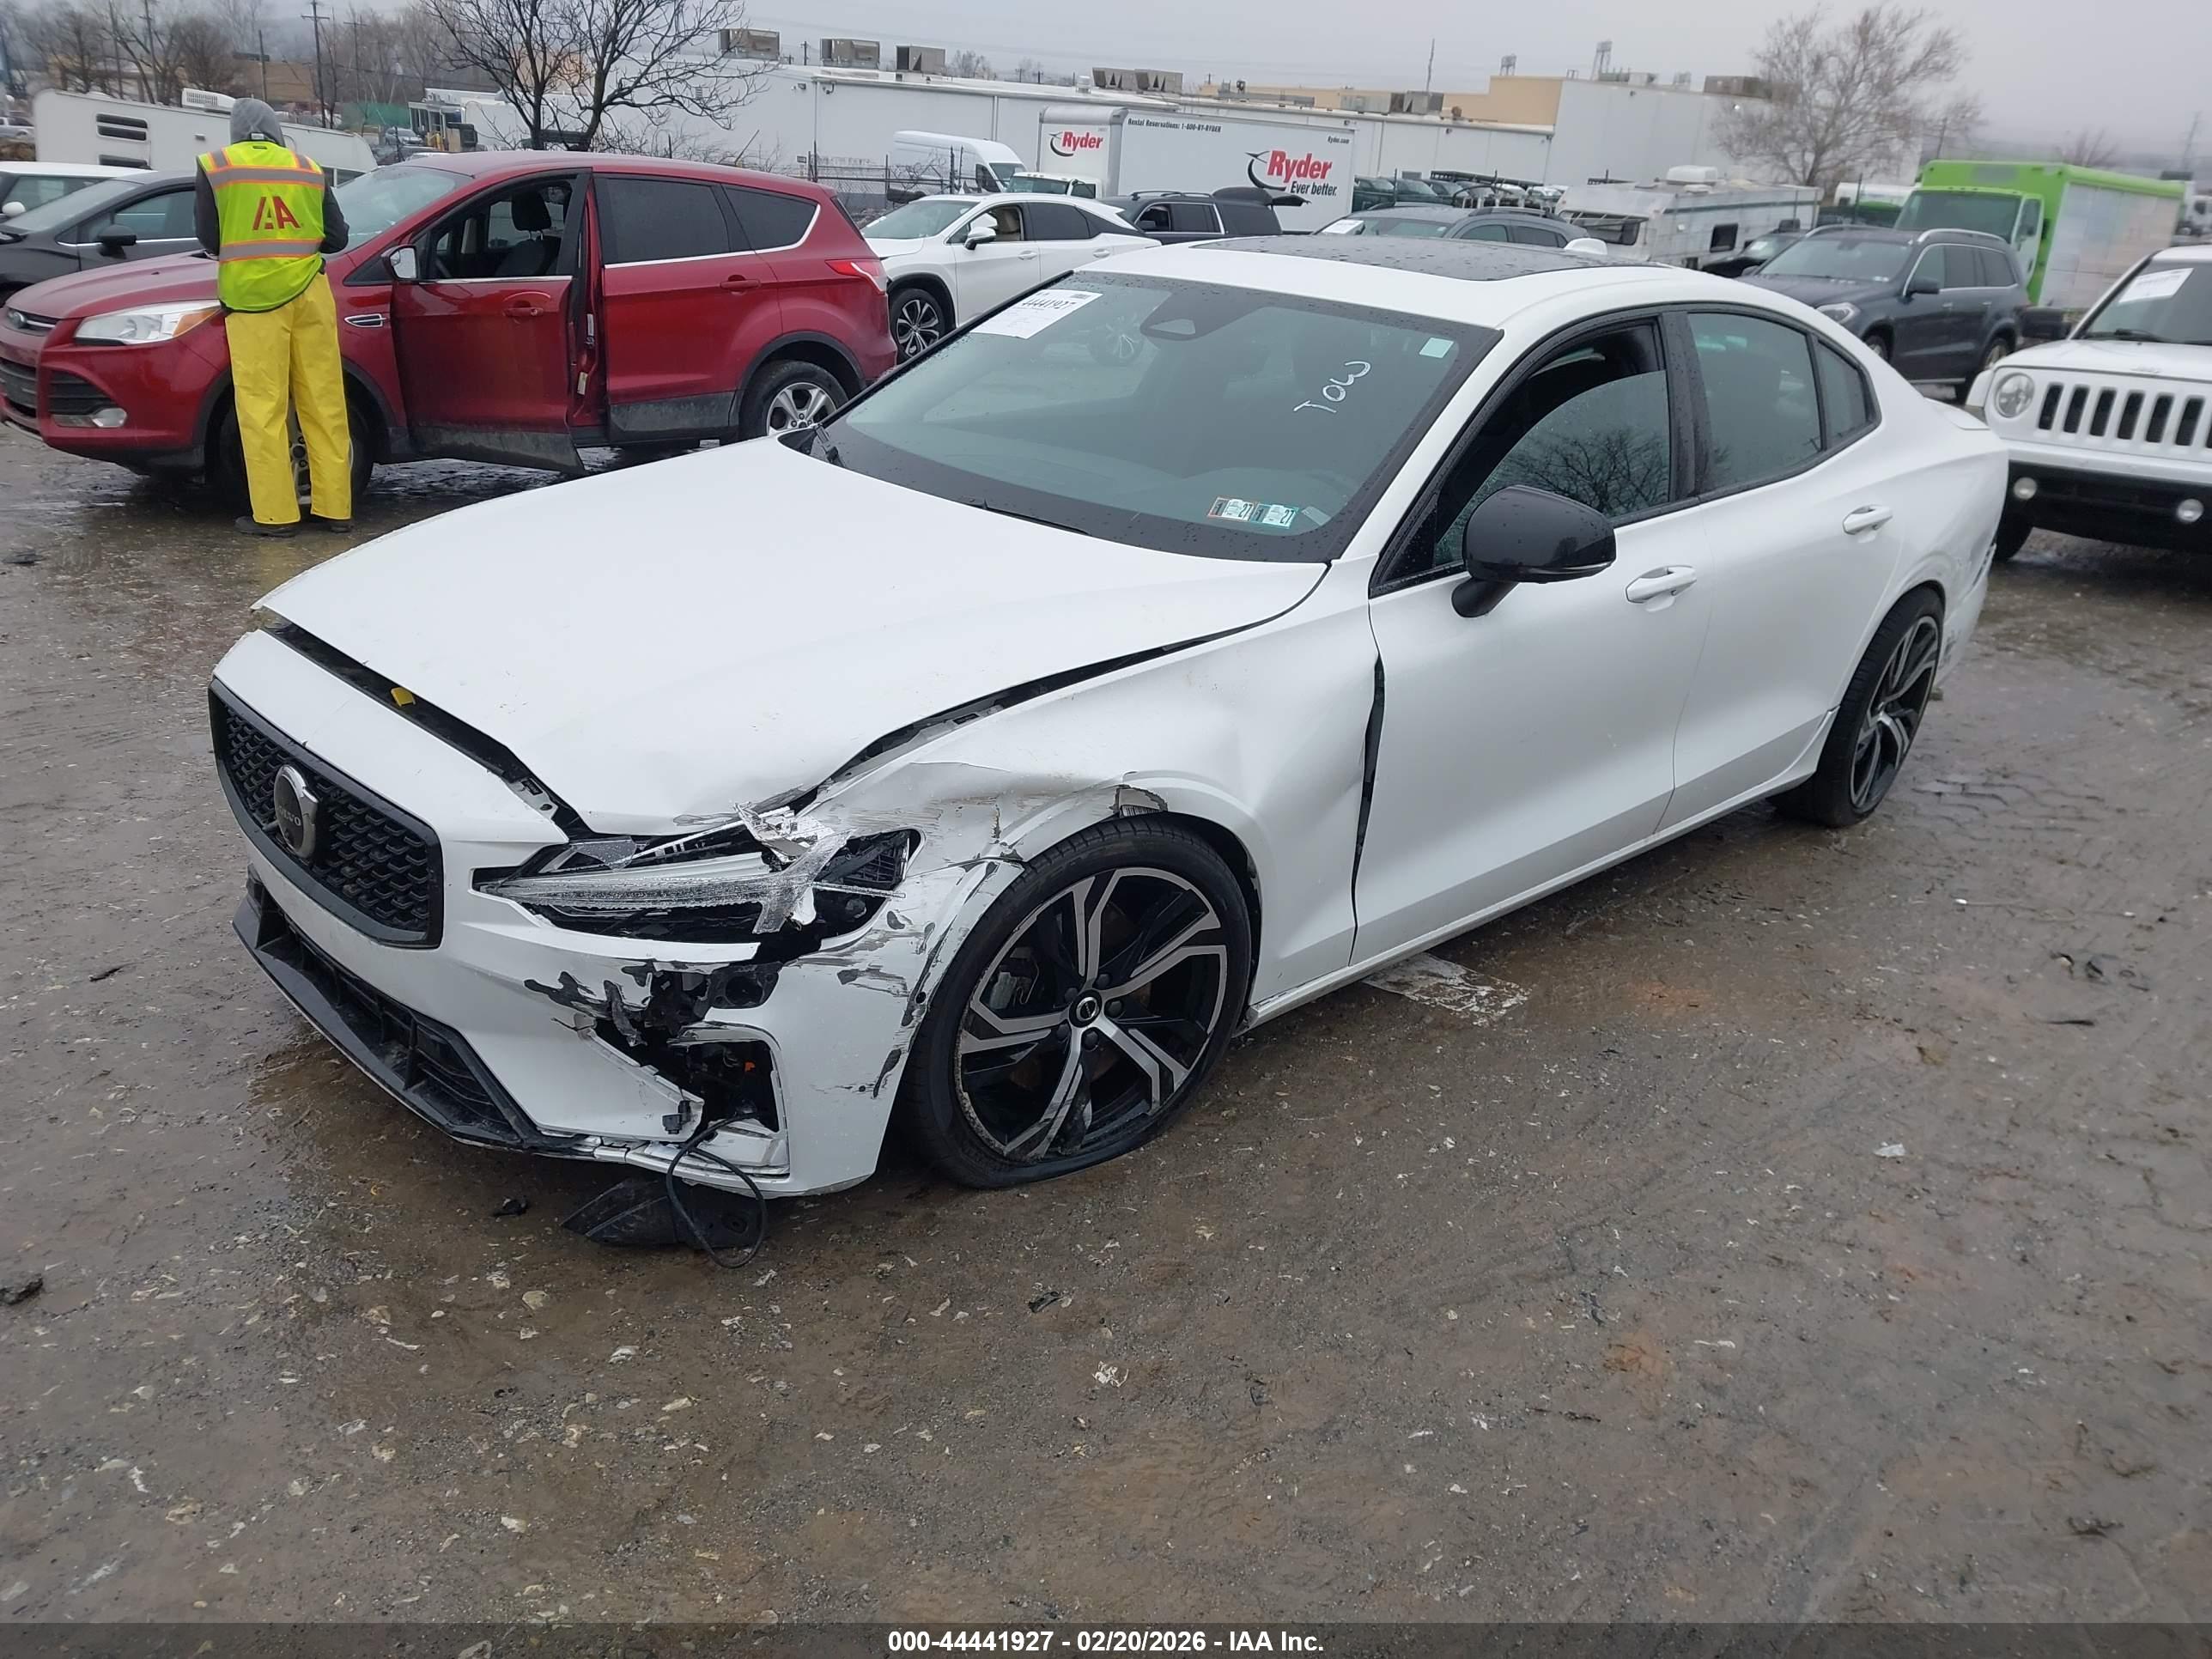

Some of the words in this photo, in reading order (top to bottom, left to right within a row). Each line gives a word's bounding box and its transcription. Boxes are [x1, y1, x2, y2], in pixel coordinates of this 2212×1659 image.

[1127, 118, 1145, 126] Rental
[1146, 119, 1181, 130] Reservations:
[1062, 131, 1103, 151] Ryder
[1328, 136, 1350, 144] Ryder.com
[1267, 150, 1333, 183] Ryder
[1291, 180, 1310, 194] Ever
[1310, 182, 1338, 197] better.
[1237, 503, 1253, 519] 27
[1279, 509, 1295, 525] 27
